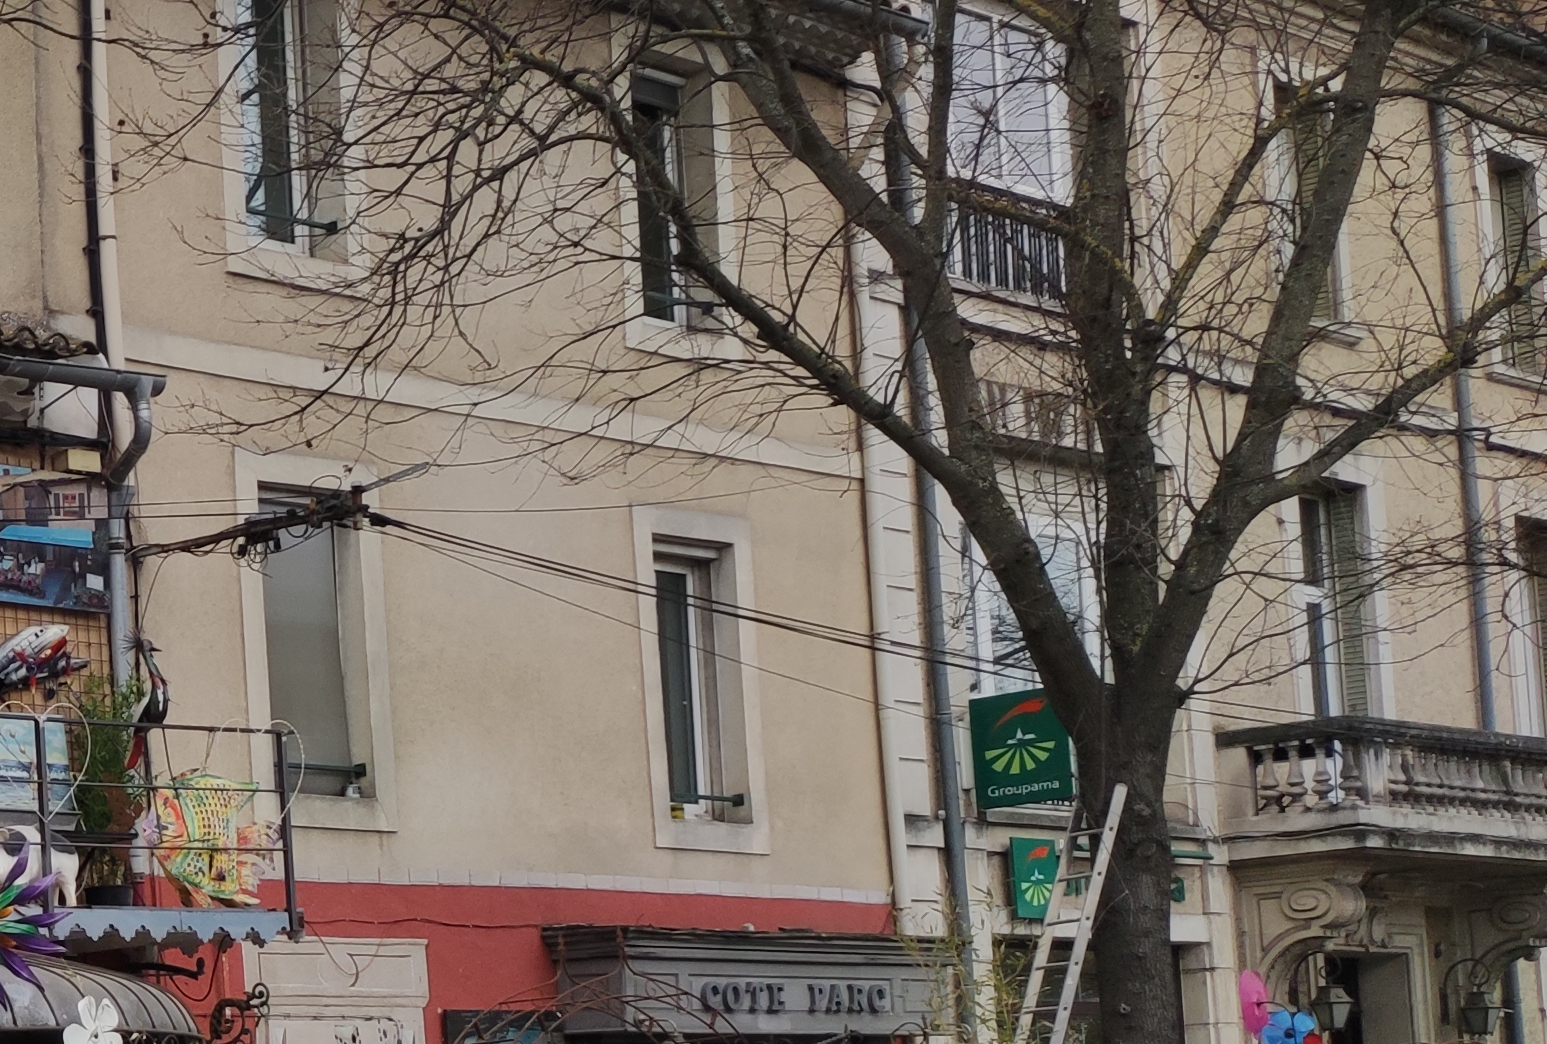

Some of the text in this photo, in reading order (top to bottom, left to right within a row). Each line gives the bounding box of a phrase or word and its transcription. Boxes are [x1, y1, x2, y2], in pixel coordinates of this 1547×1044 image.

[987, 780, 1060, 797] Groupama
[700, 980, 887, 1014] COTE PARC
